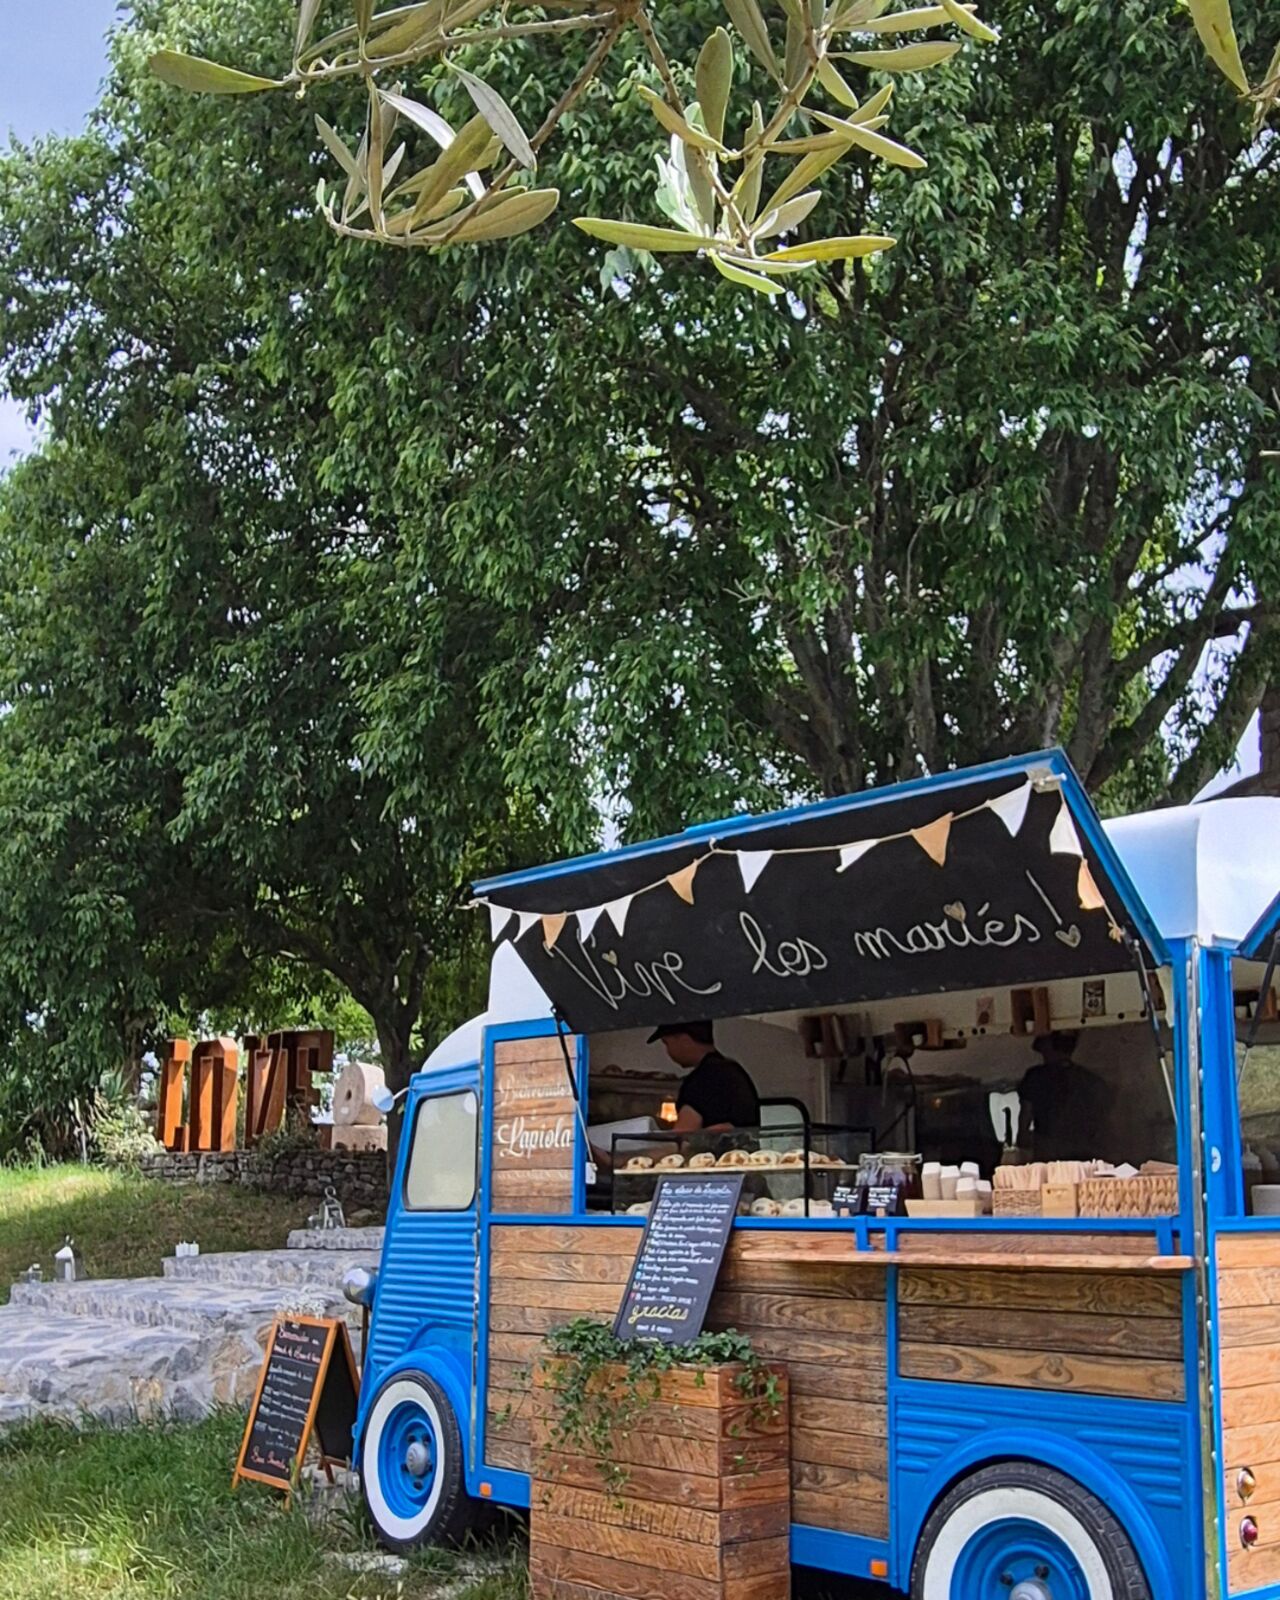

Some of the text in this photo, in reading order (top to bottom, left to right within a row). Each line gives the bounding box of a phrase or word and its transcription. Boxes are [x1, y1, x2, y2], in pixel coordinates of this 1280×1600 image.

[542, 928, 722, 1010] Vive
[739, 911, 828, 977] les
[497, 1116, 571, 1159] Lapiola
